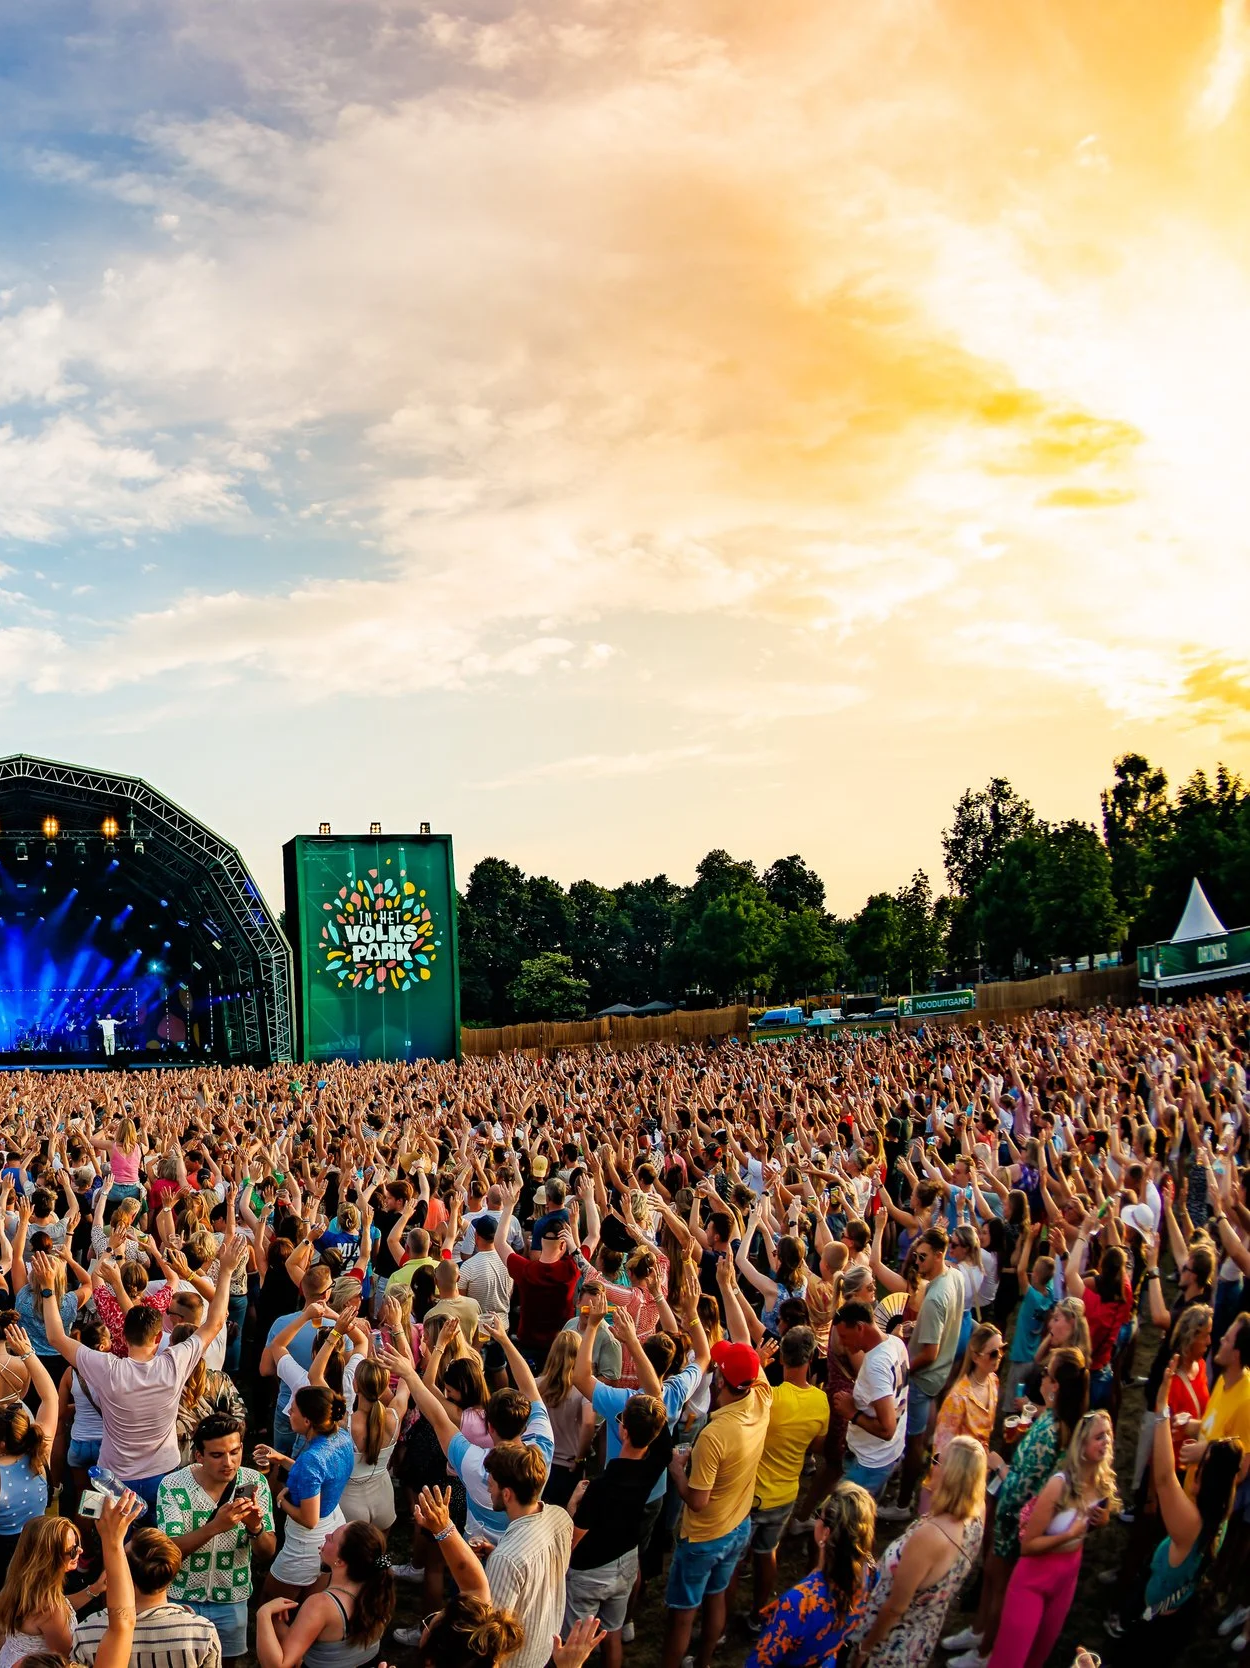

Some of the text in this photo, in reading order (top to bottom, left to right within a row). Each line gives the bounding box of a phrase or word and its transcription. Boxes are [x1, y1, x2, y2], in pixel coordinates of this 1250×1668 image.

[358, 910, 401, 925] IN HET
[344, 923, 418, 943] VOLKS
[352, 943, 412, 962] PARK
[916, 996, 970, 1009] NOODUITGANG
